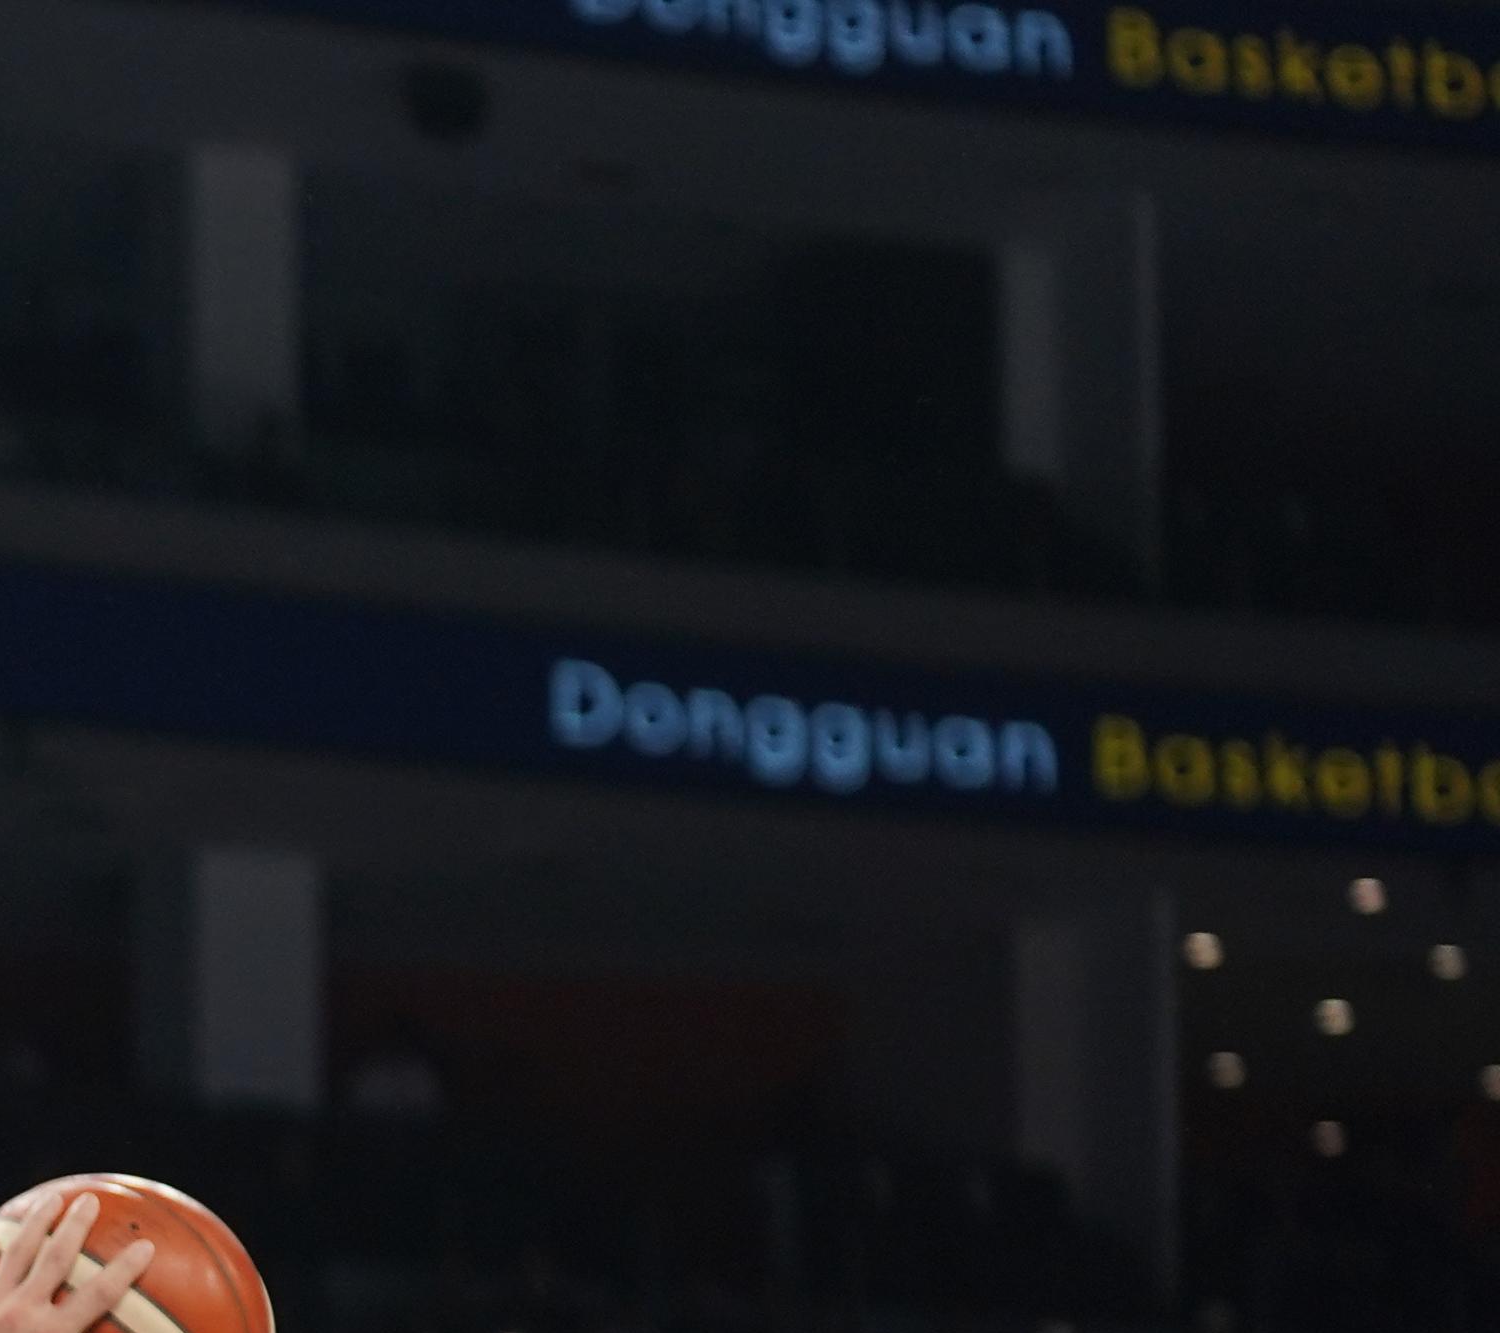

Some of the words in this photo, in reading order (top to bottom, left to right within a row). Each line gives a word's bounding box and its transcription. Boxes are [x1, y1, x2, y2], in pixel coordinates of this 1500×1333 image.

[568, 0, 1073, 78] gguan
[1104, 8, 1500, 120] Basketb
[548, 658, 1060, 794] Dongguan
